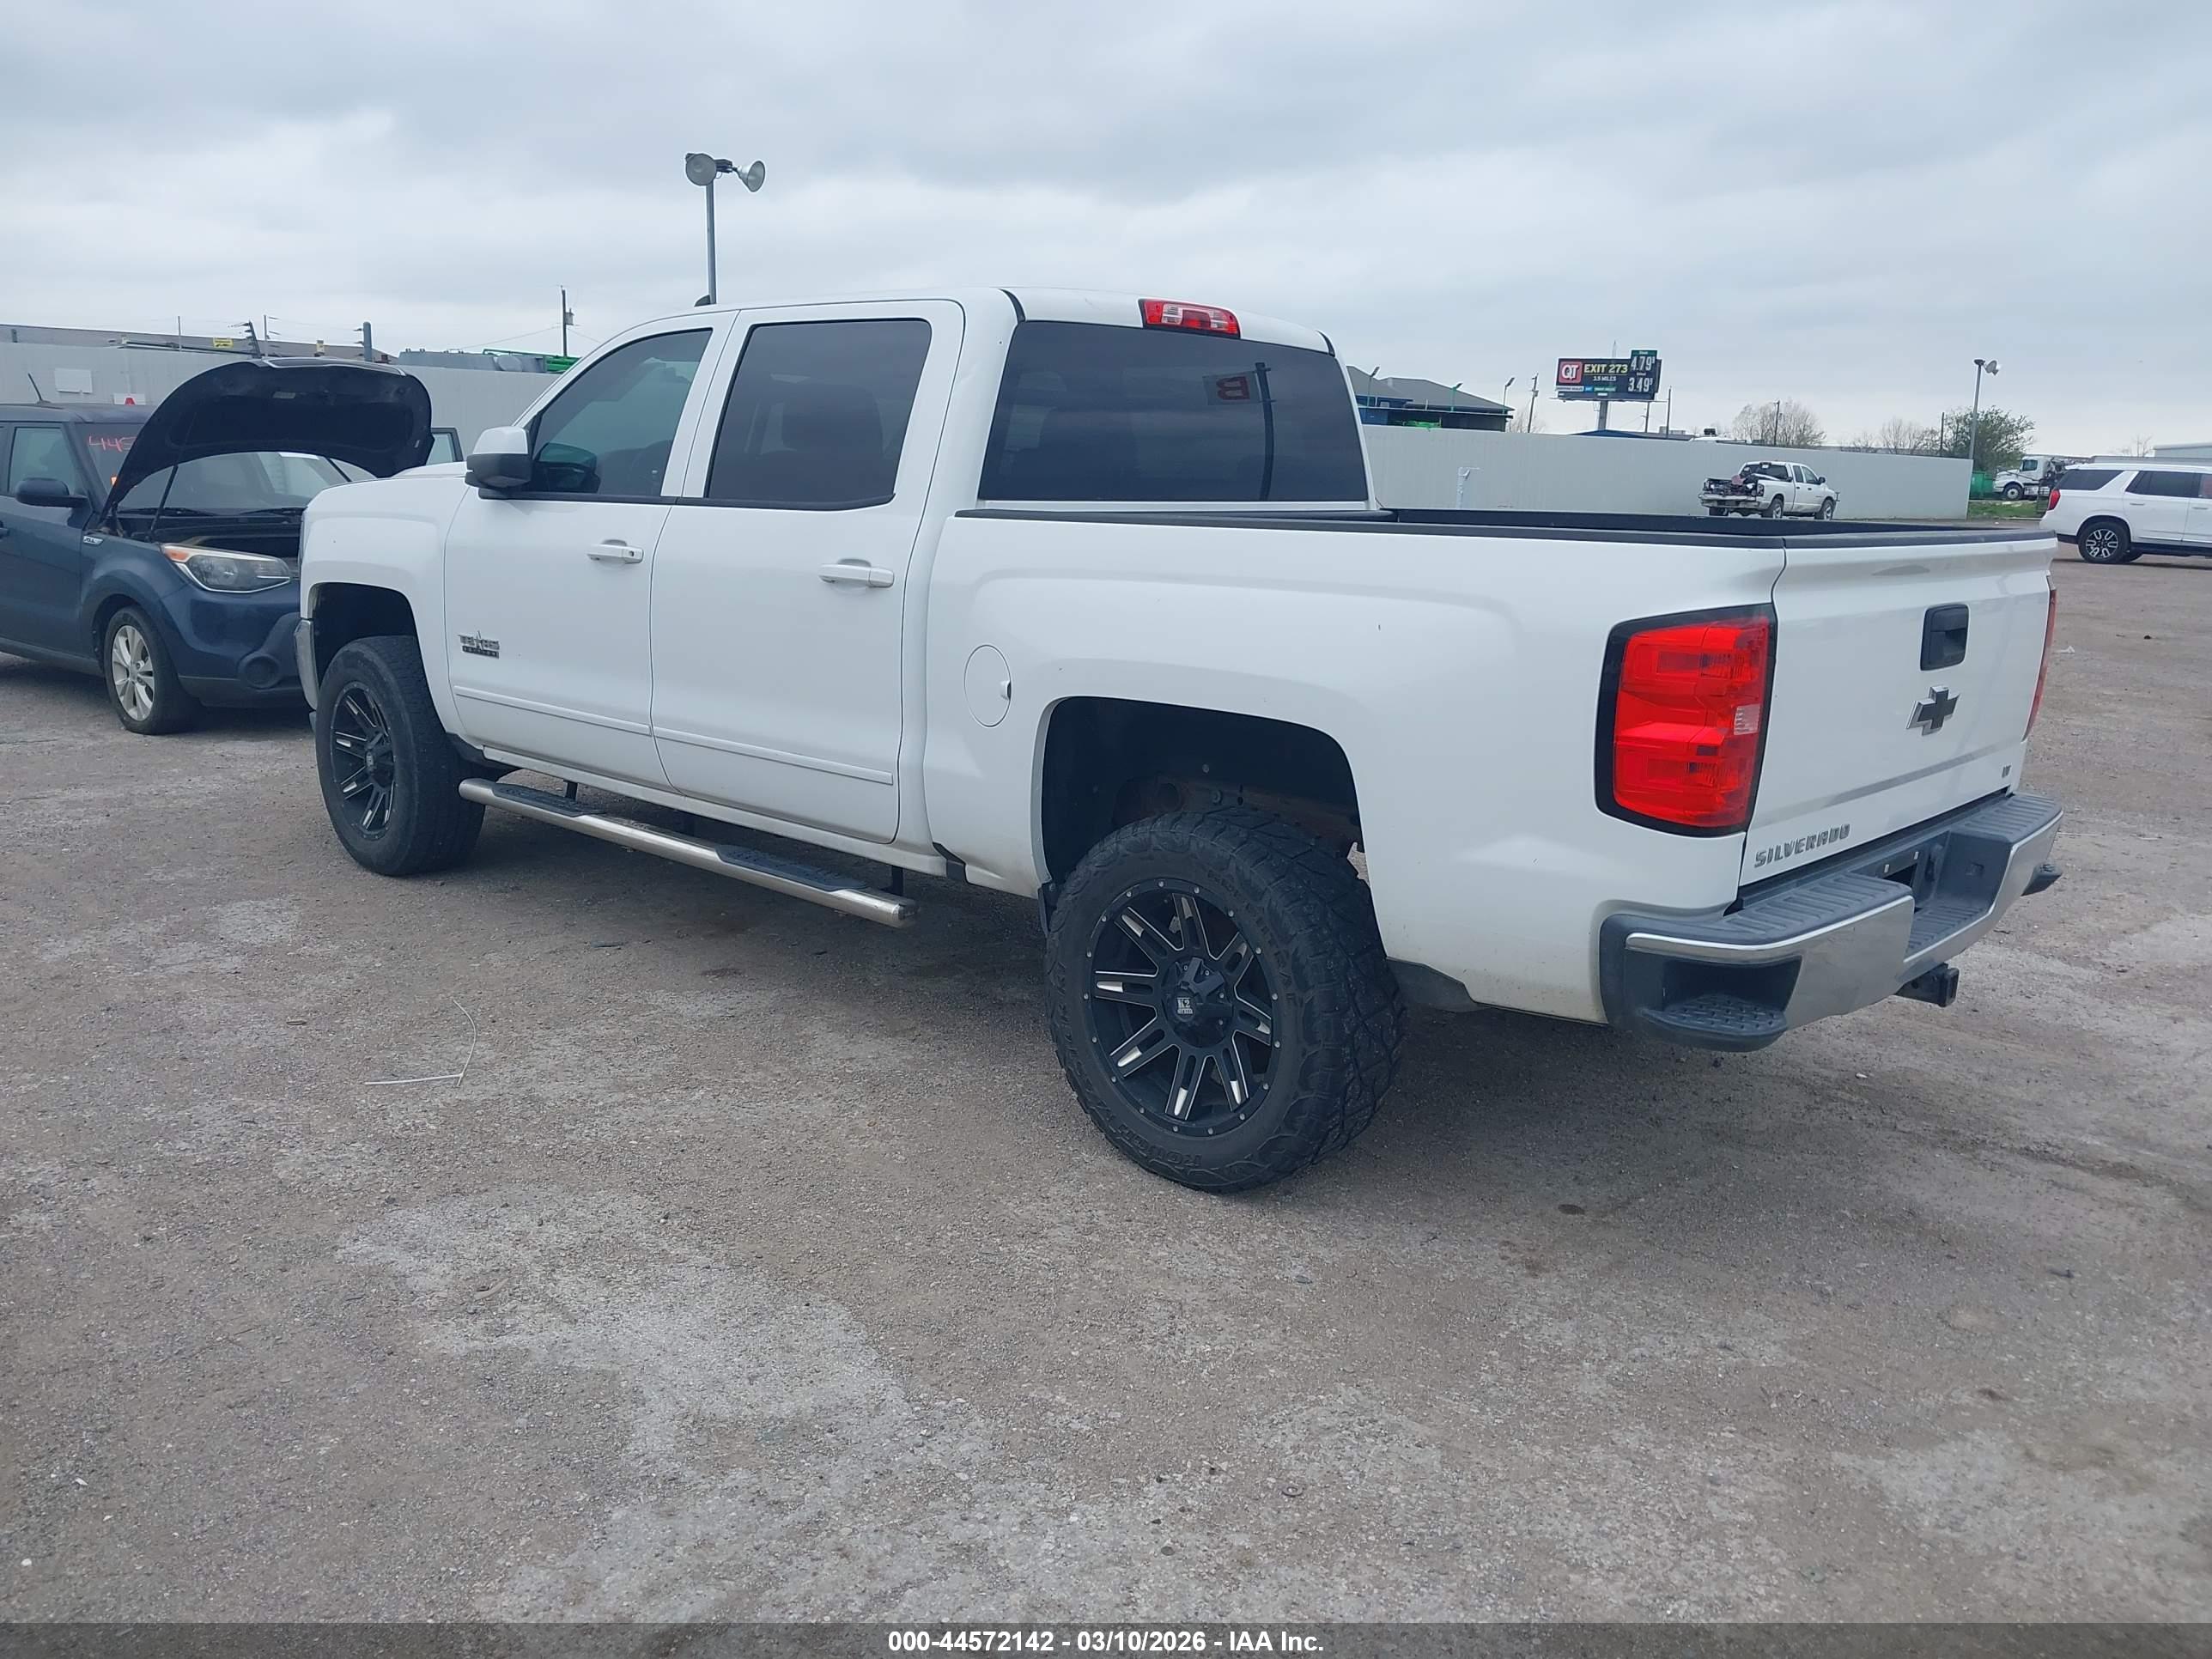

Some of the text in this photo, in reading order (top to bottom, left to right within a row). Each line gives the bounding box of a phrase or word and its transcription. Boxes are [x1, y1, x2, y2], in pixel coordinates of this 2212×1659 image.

[1561, 364, 1579, 380] QT
[1583, 363, 1628, 374] EXIT 273
[1754, 823, 1850, 868] SILVERADO
